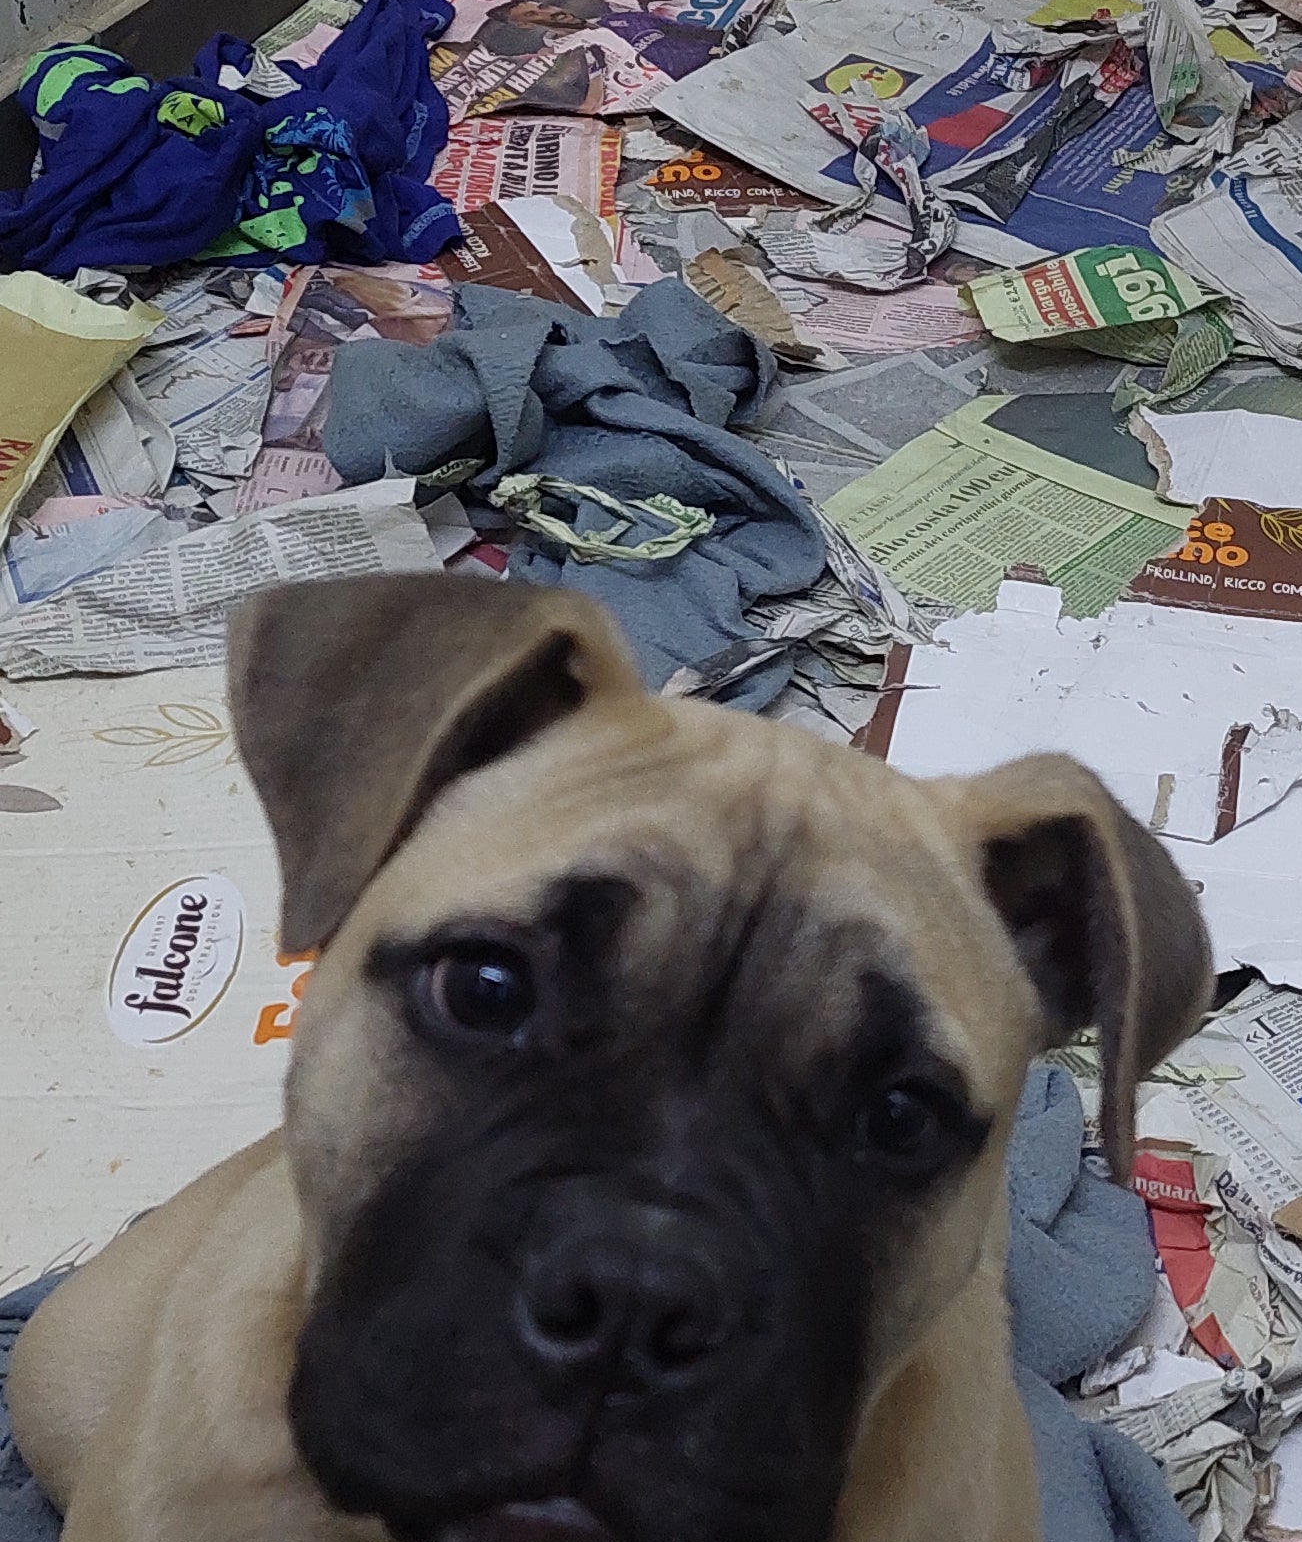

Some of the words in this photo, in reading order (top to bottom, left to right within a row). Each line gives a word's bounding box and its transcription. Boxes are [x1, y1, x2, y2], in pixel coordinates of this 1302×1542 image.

[703, 186, 741, 199] RICCO
[903, 497, 959, 542] costa
[950, 472, 992, 509] 100
[1145, 565, 1218, 589] FROLLINO,
[1223, 575, 1267, 592] RICCO
[123, 892, 209, 1020] falcone
